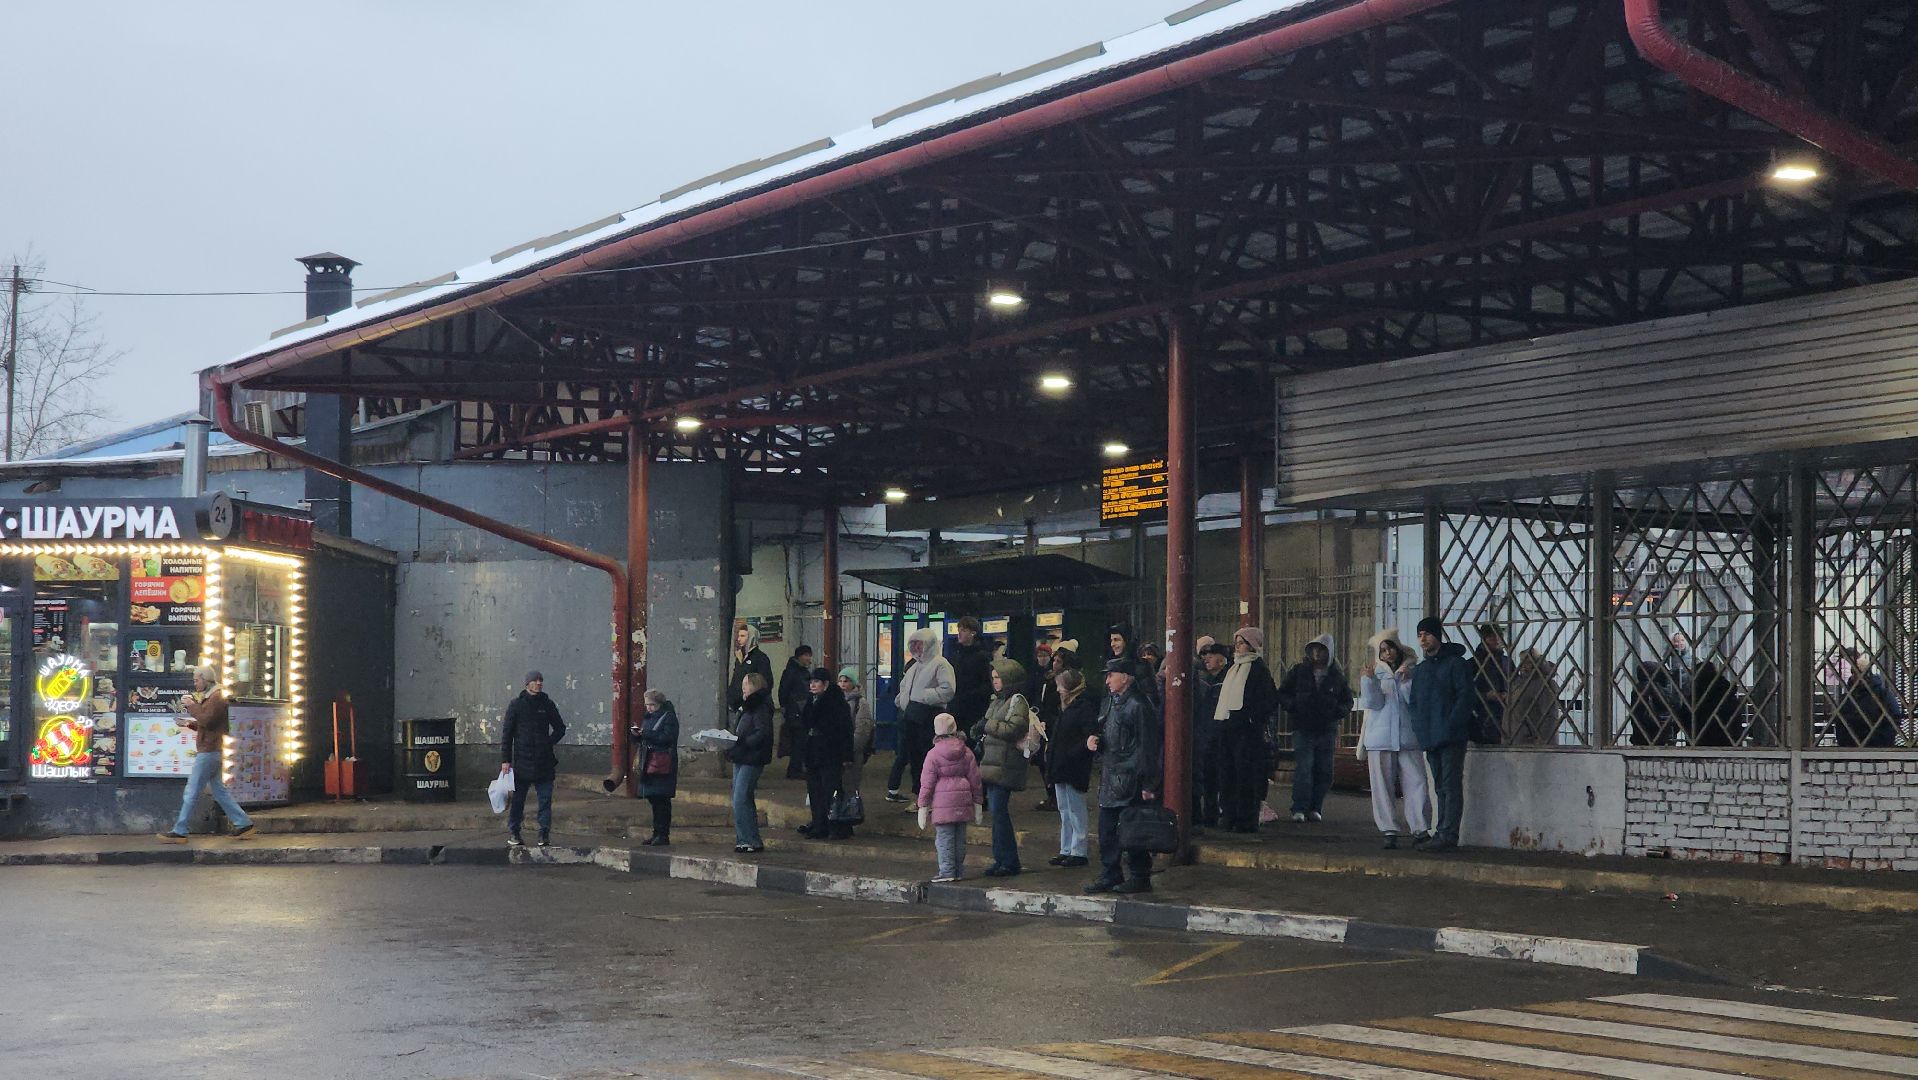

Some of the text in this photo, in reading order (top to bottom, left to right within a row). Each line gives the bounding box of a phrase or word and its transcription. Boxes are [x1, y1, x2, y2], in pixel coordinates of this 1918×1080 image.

[215, 506, 226, 523] 24
[21, 506, 180, 538] ШАУРМА
[167, 614, 202, 622] ВЫПЕЧКА
[39, 653, 89, 678] ШАУРМА
[414, 735, 450, 745] ШАШЛЫК
[416, 780, 449, 789] ШАУРМА
